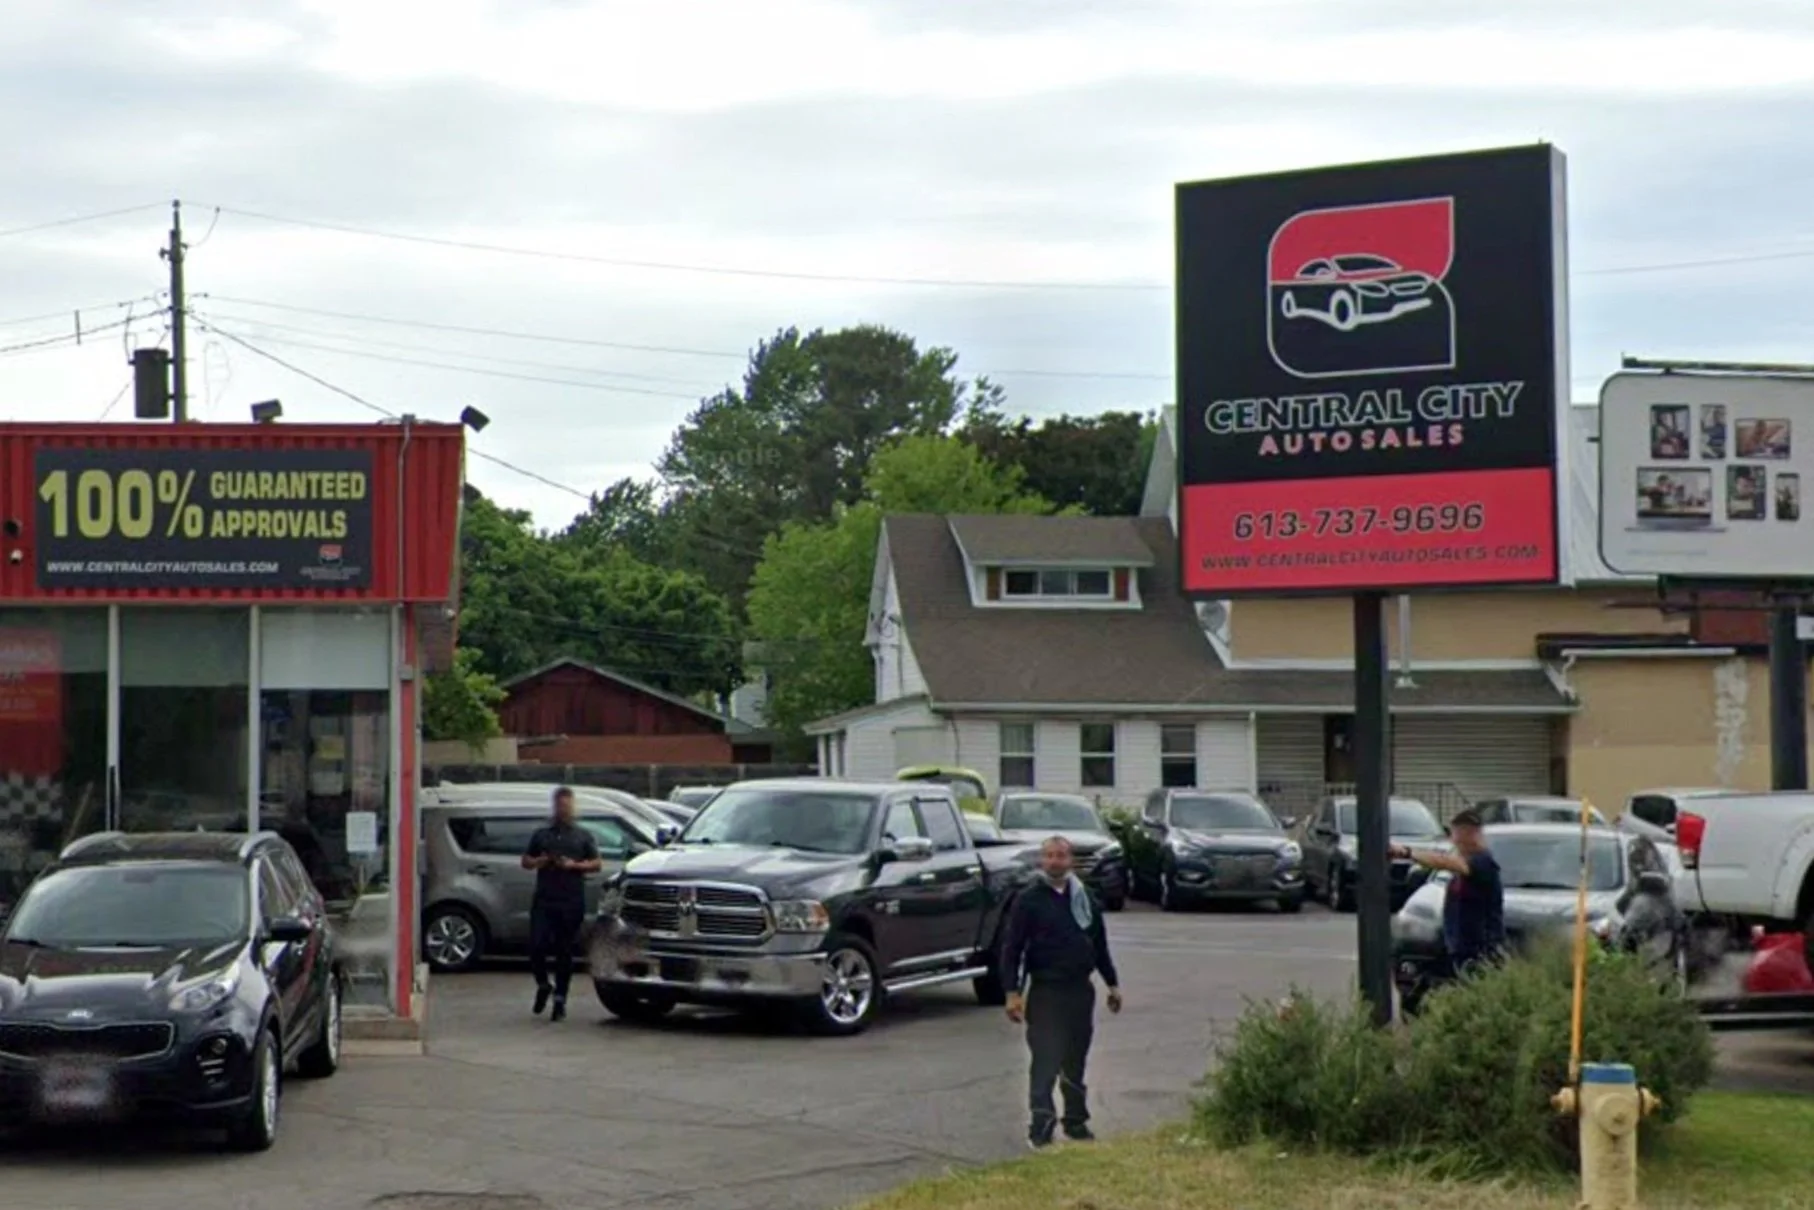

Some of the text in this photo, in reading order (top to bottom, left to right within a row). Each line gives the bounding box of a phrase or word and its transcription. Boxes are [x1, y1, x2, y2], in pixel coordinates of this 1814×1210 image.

[1205, 381, 1524, 433] CENTRAL CITY
[210, 471, 366, 500] GUARANTEED
[39, 470, 204, 538] 100%
[210, 510, 347, 538] APPROVALS
[1234, 502, 1485, 541] 613-737-9696
[1203, 546, 1540, 571] WWWCENTRALCITYAUTOSALESCOM
